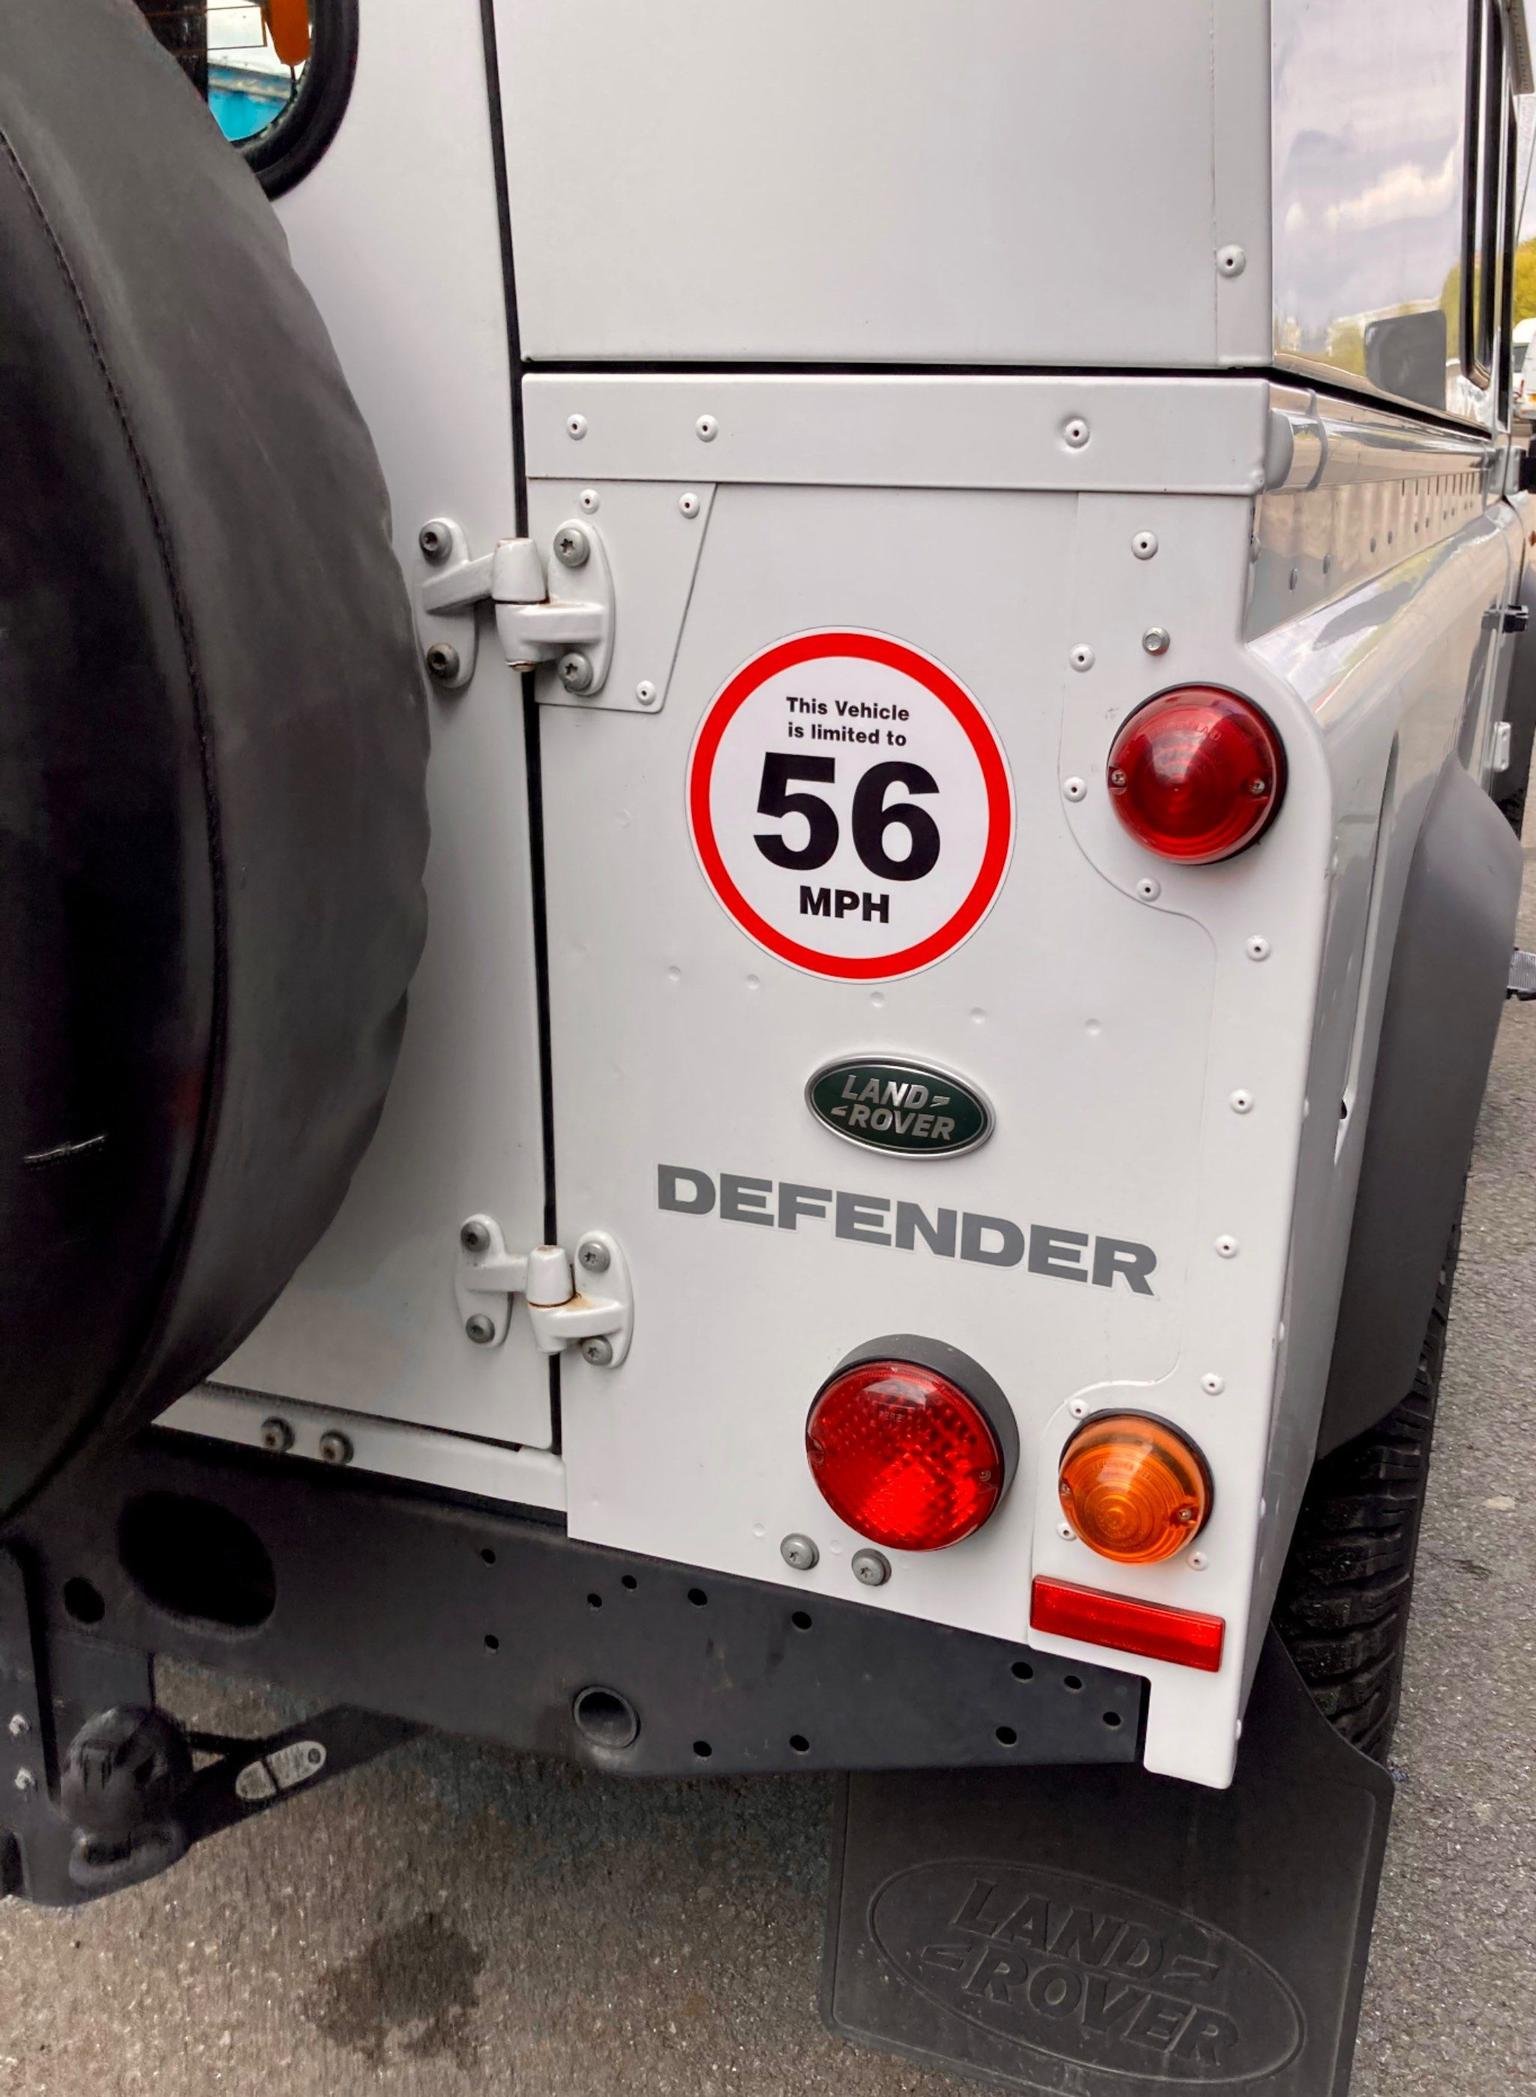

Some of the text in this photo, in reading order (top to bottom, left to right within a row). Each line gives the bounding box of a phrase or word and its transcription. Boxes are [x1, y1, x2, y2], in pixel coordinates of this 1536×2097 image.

[786, 696, 910, 721] This Vehicle
[788, 722, 907, 747] is limited to
[753, 751, 941, 882] 56
[799, 885, 890, 924] MPH
[841, 1074, 929, 1110] LAND
[848, 1104, 956, 1141] ROVER
[657, 1163, 1158, 1296] DEFENDER
[950, 1878, 1166, 1978] LAND
[961, 1944, 1240, 2066] ROVER
